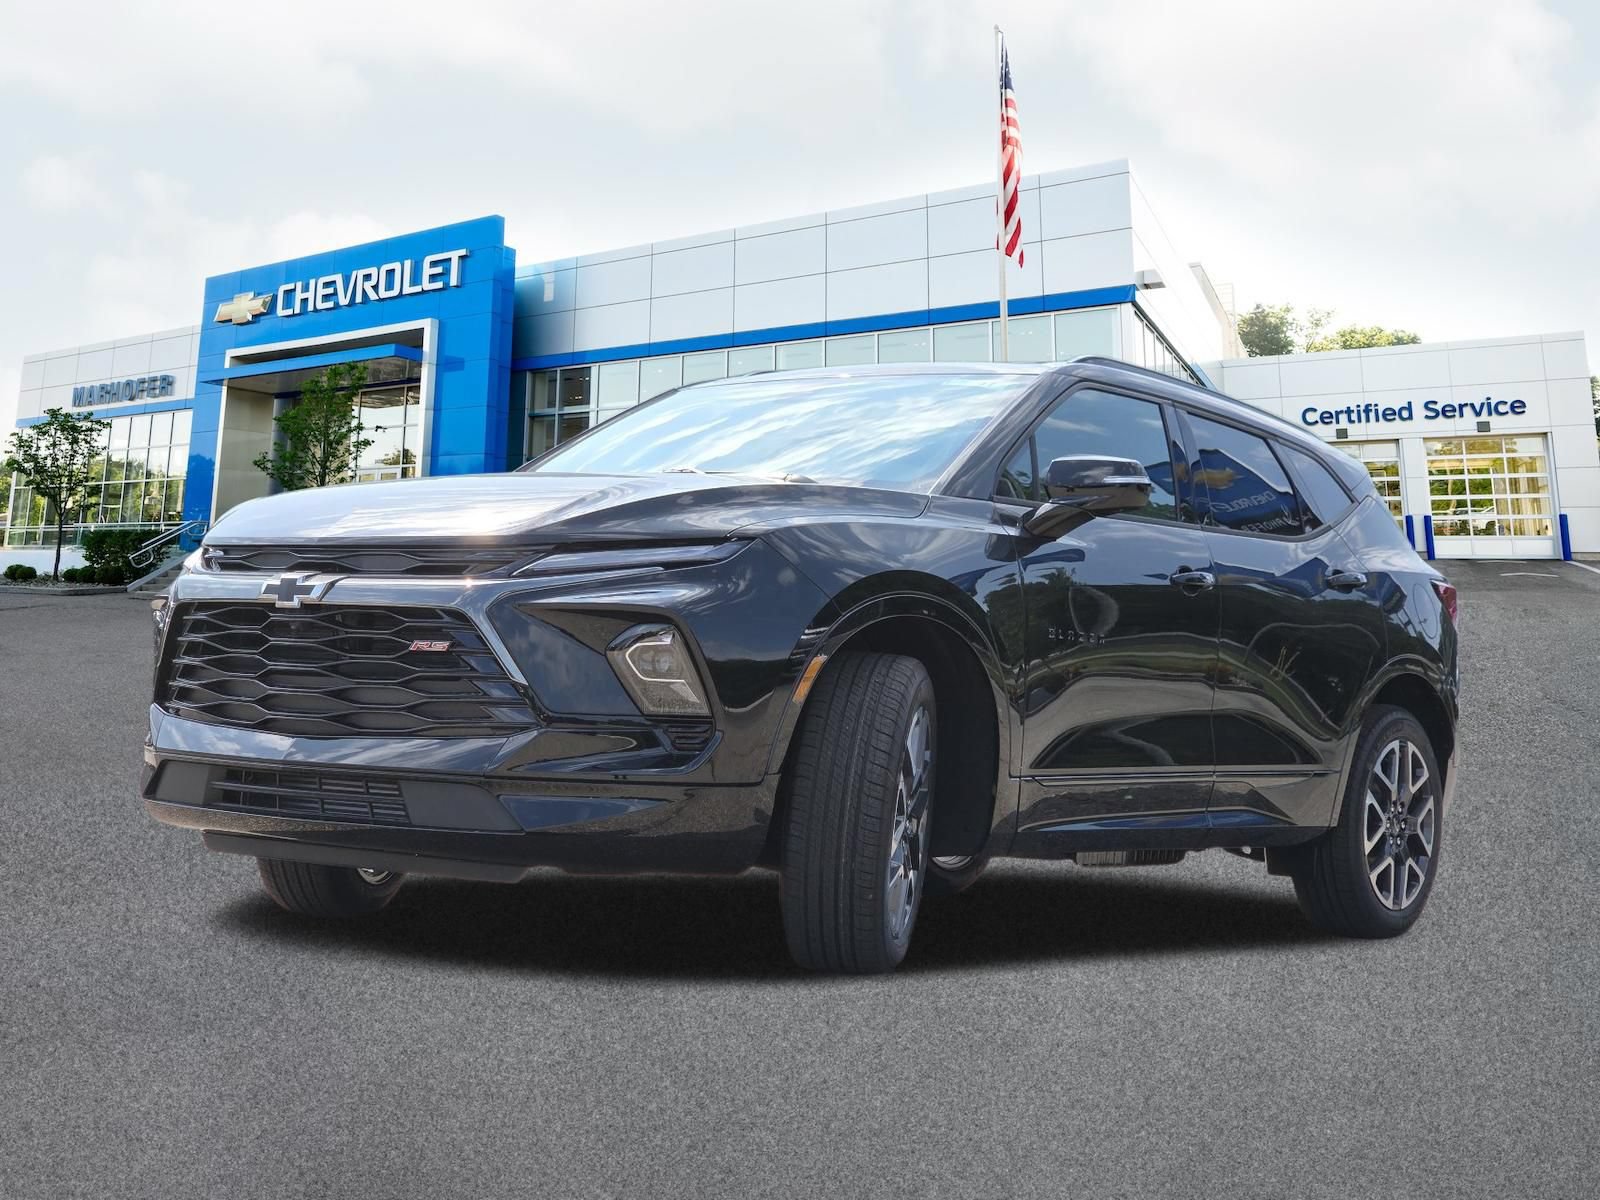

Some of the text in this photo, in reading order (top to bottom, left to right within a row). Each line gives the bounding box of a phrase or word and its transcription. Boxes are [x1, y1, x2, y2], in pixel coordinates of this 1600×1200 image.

[276, 248, 470, 317] CHEVROLET
[72, 374, 175, 407] MARHOFER
[1301, 397, 1527, 426] Certified Service
[409, 639, 450, 652] RS
